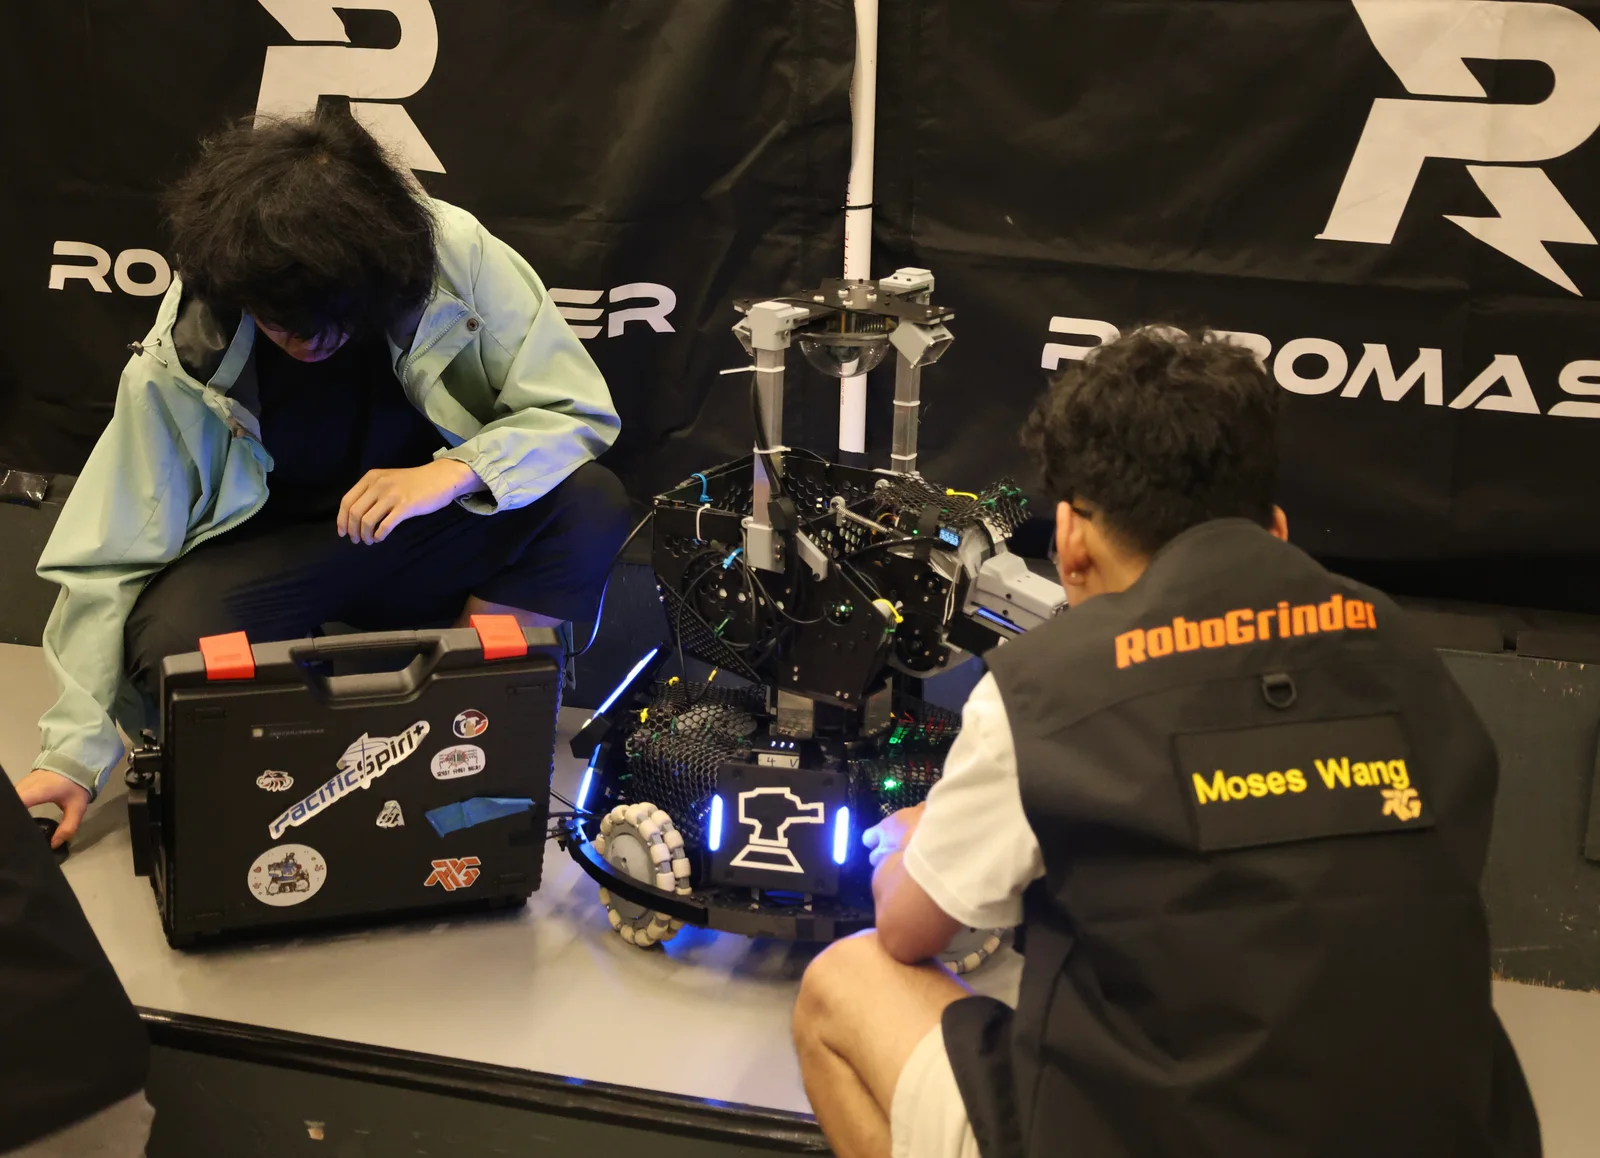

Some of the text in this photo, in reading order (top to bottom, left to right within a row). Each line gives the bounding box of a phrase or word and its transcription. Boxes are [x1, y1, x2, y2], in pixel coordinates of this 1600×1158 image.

[1115, 594, 1377, 669] RoboGrinder
[1192, 757, 1410, 804] Moses Wang
